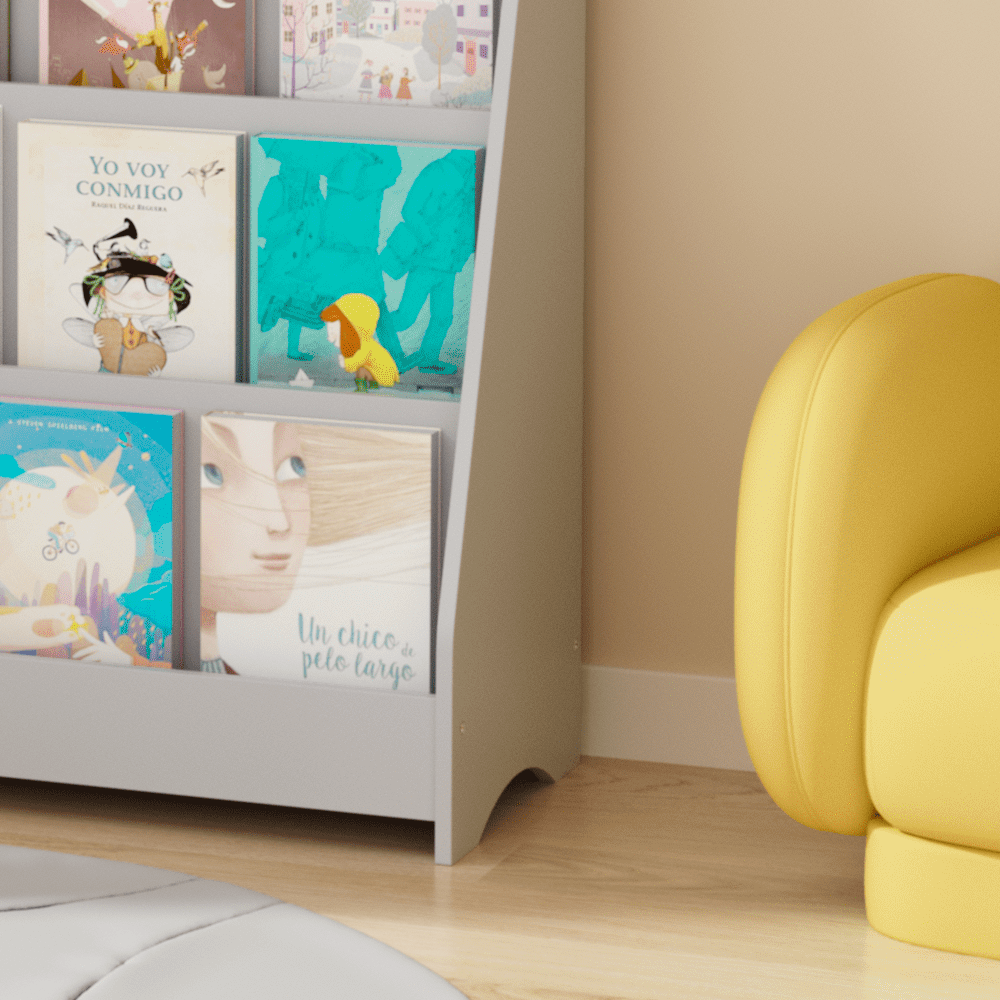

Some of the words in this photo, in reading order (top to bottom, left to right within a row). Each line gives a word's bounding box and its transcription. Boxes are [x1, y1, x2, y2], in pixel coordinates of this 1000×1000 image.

[75, 179, 184, 202] CONMIGO
[298, 612, 332, 645] Un
[337, 618, 400, 651] chico
[401, 641, 416, 658] de
[301, 646, 350, 679] pelo
[354, 650, 417, 692] largo
